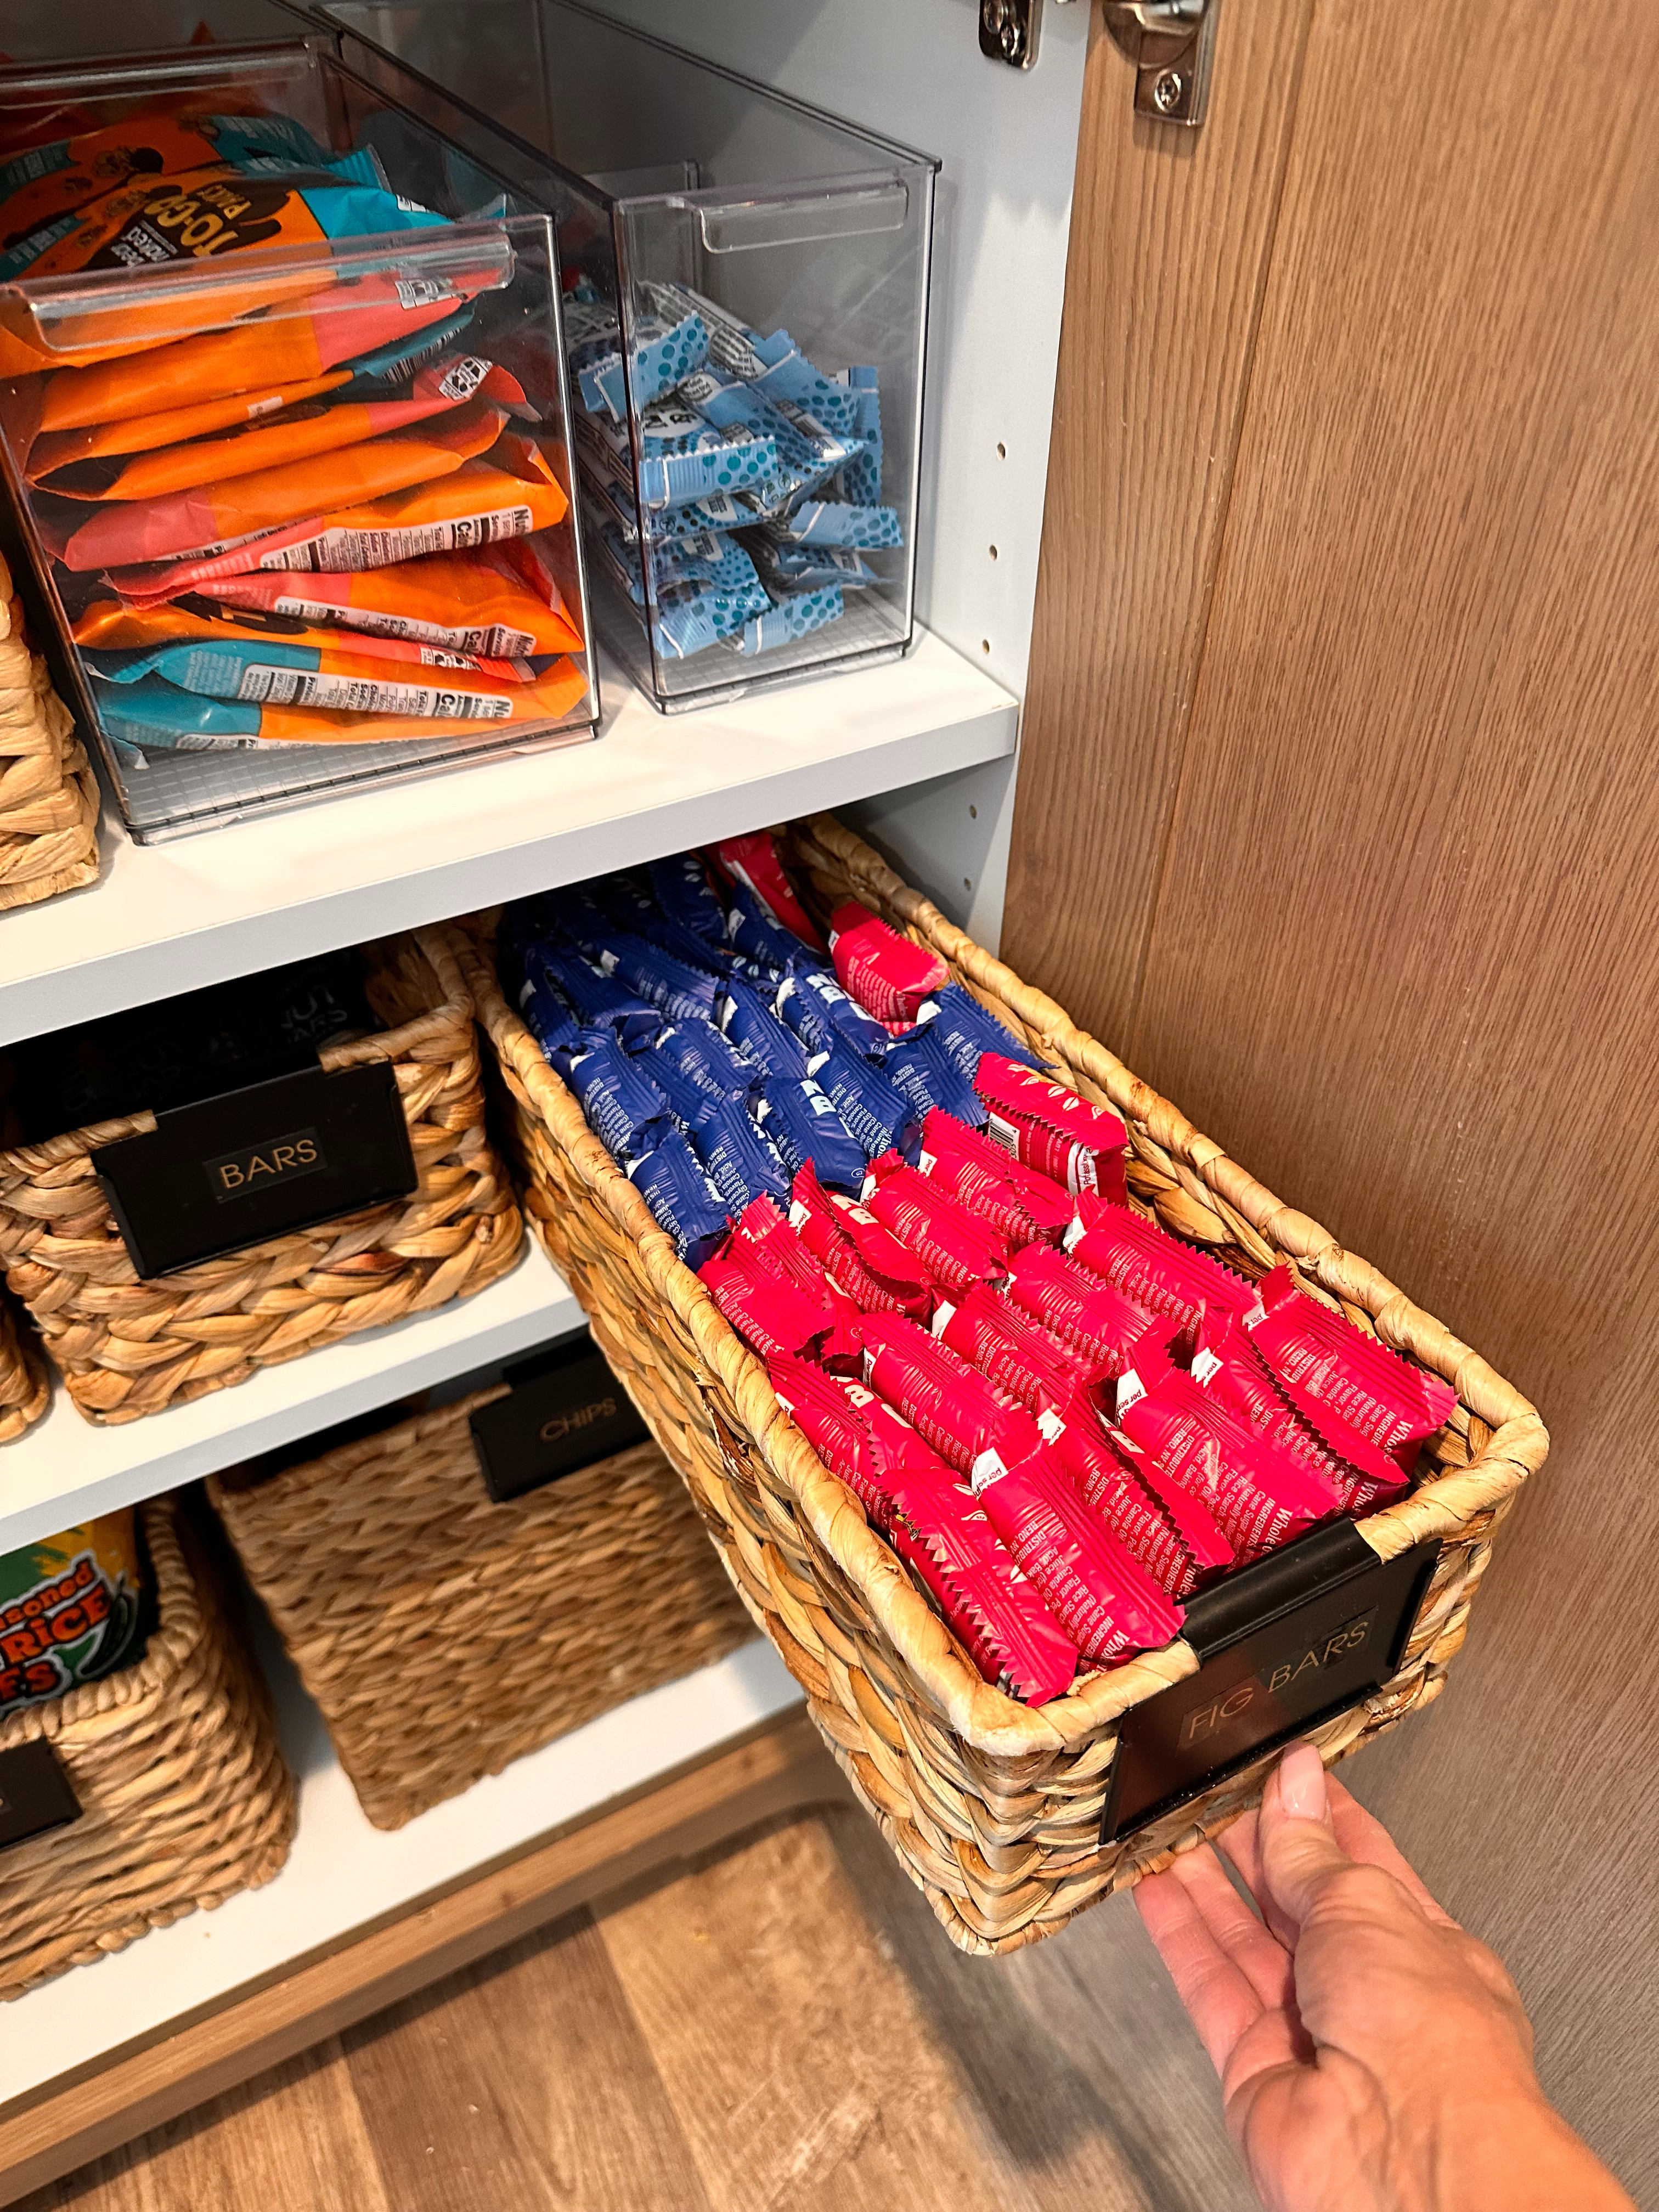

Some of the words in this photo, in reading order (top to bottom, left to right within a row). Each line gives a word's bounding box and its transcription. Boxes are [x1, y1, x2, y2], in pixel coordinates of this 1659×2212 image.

[219, 1139, 318, 1189] BARS
[1325, 1375, 1349, 1403] Canola
[1350, 1389, 1367, 1408] Rice
[540, 1397, 617, 1442] CHIPS
[1367, 1402, 1386, 1424] Cane
[1215, 1467, 1239, 1494] Flavor,
[1229, 1474, 1248, 1494] Rice
[1113, 1494, 1133, 1517] Juice
[1228, 1482, 1258, 1520] (Naturally
[1247, 1489, 1266, 1511] Cane
[1120, 1502, 1142, 1530] Canola
[1129, 1510, 1152, 1538] Flavor,
[1143, 1519, 1161, 1538] Rice
[1235, 1508, 1255, 1534] Sugar,
[1145, 1526, 1171, 1564] (Naturally
[1043, 1553, 1066, 1576] Juice
[1047, 1564, 1074, 1590] Canola
[1153, 1554, 1171, 1580] Sugar,
[1054, 1573, 1082, 1600] Flavor,
[1070, 1583, 1090, 1604] Rice
[1066, 1593, 1098, 1629] (Naturally
[1084, 1604, 1106, 1627] Cane
[1188, 1688, 1254, 1739] FIG
[1268, 1622, 1368, 1694] BARS
